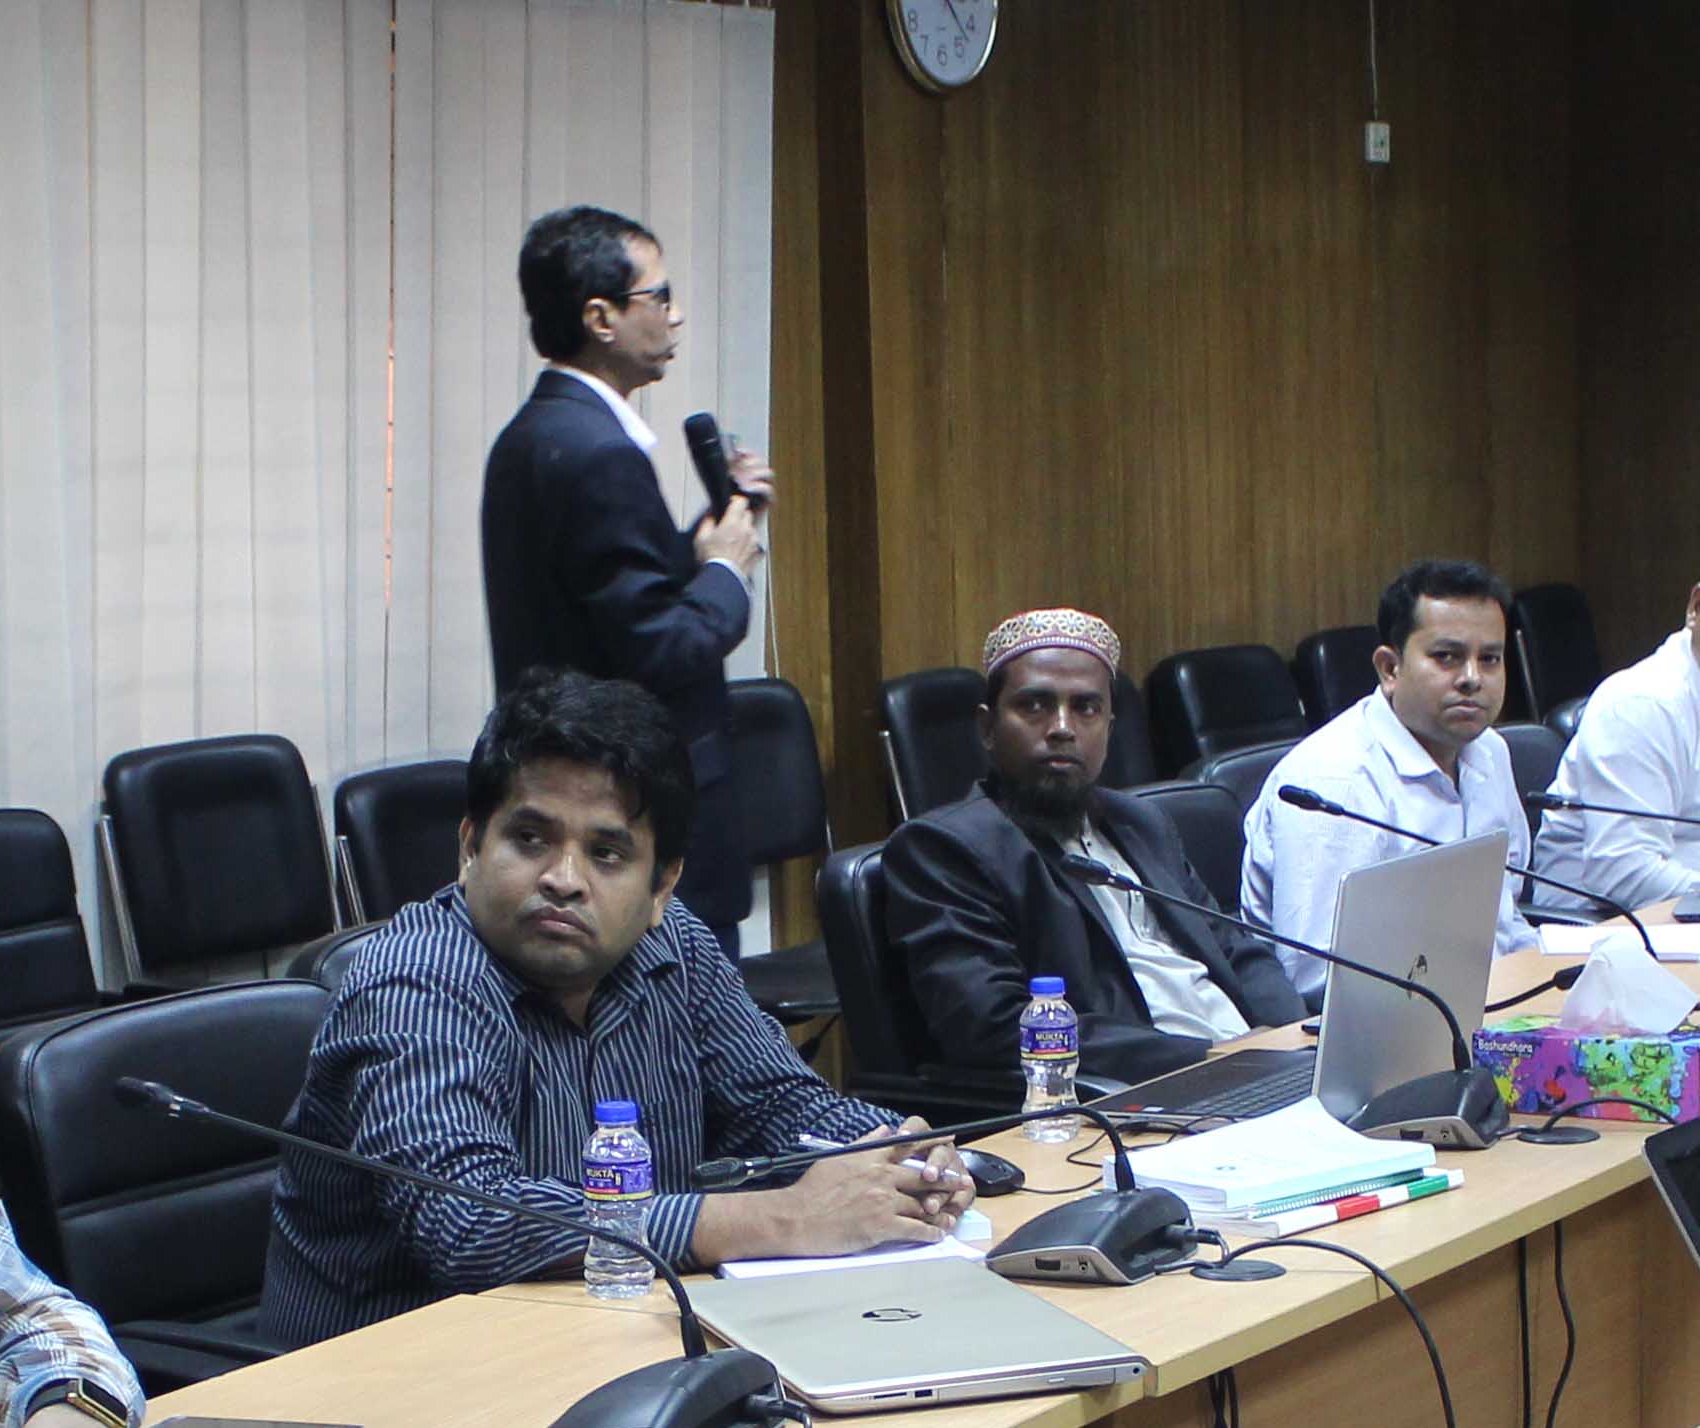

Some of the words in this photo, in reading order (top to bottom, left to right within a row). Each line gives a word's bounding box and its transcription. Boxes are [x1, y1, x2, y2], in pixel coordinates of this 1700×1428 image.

[907, 8, 919, 33] 8
[965, 13, 976, 32] 4
[920, 33, 930, 57] 7
[936, 43, 948, 66] 6
[954, 34, 966, 59] 5
[1478, 1038, 1533, 1054] Bashundhara
